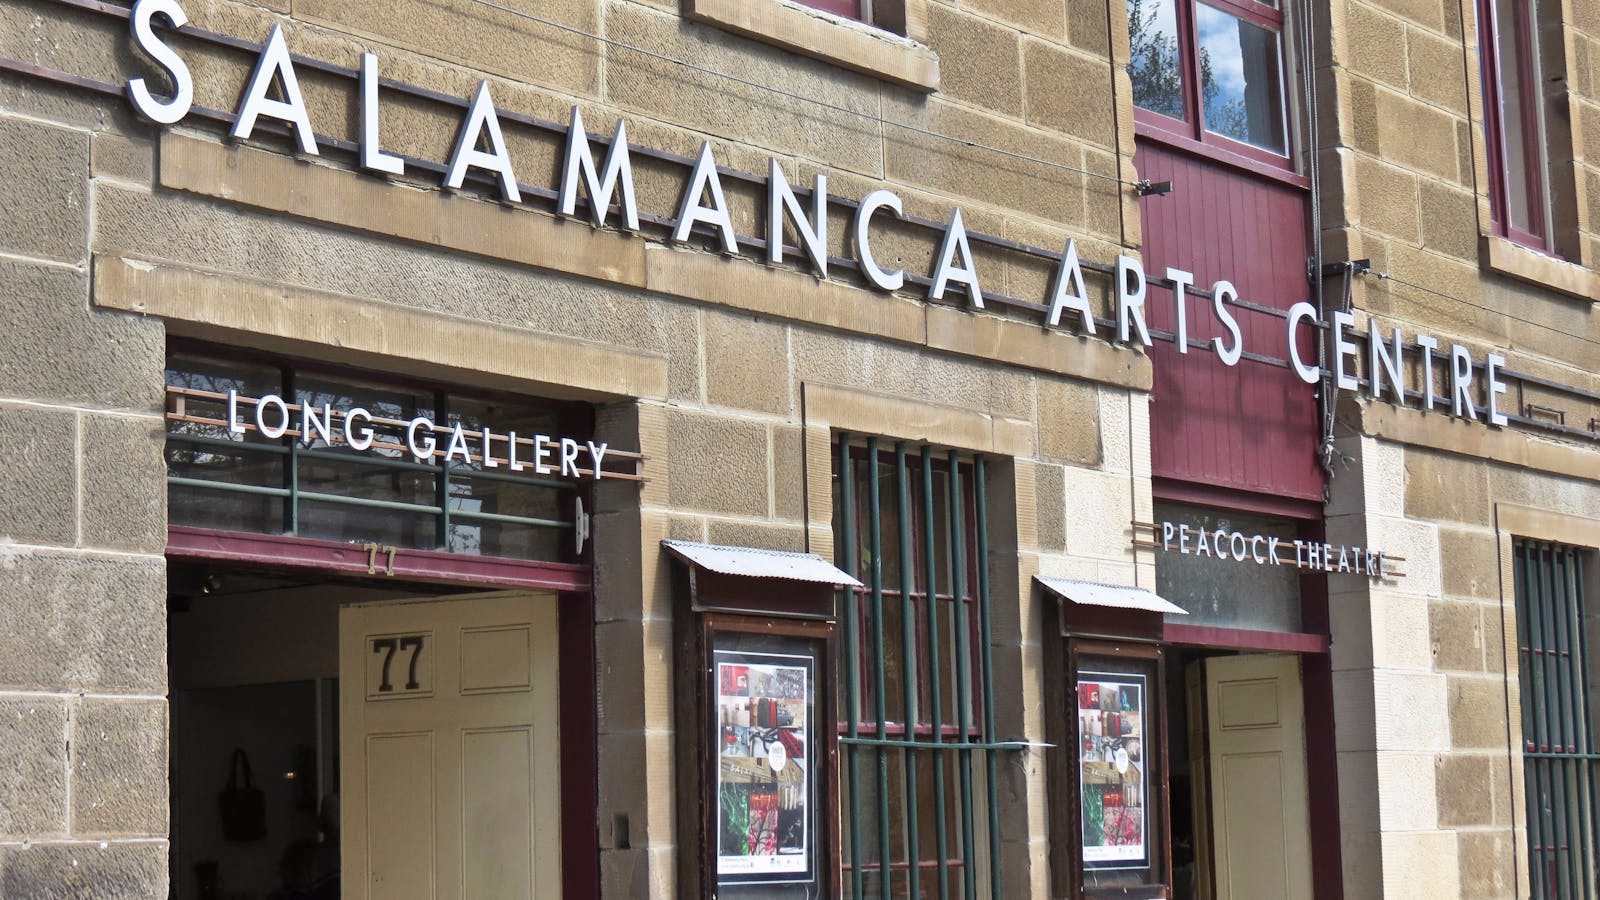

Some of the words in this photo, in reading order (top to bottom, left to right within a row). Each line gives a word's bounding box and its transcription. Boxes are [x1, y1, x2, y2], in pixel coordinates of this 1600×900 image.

[127, 0, 984, 309] SALAMANCA
[1045, 238, 1242, 367] ARTS
[1286, 301, 1508, 426] CENTRE
[228, 389, 375, 451] LONG
[407, 417, 608, 480] GALLERY
[364, 543, 397, 576] 77
[1163, 521, 1280, 565] PEACOCK
[1293, 540, 1388, 577] THEATRE
[373, 636, 424, 692] 77
